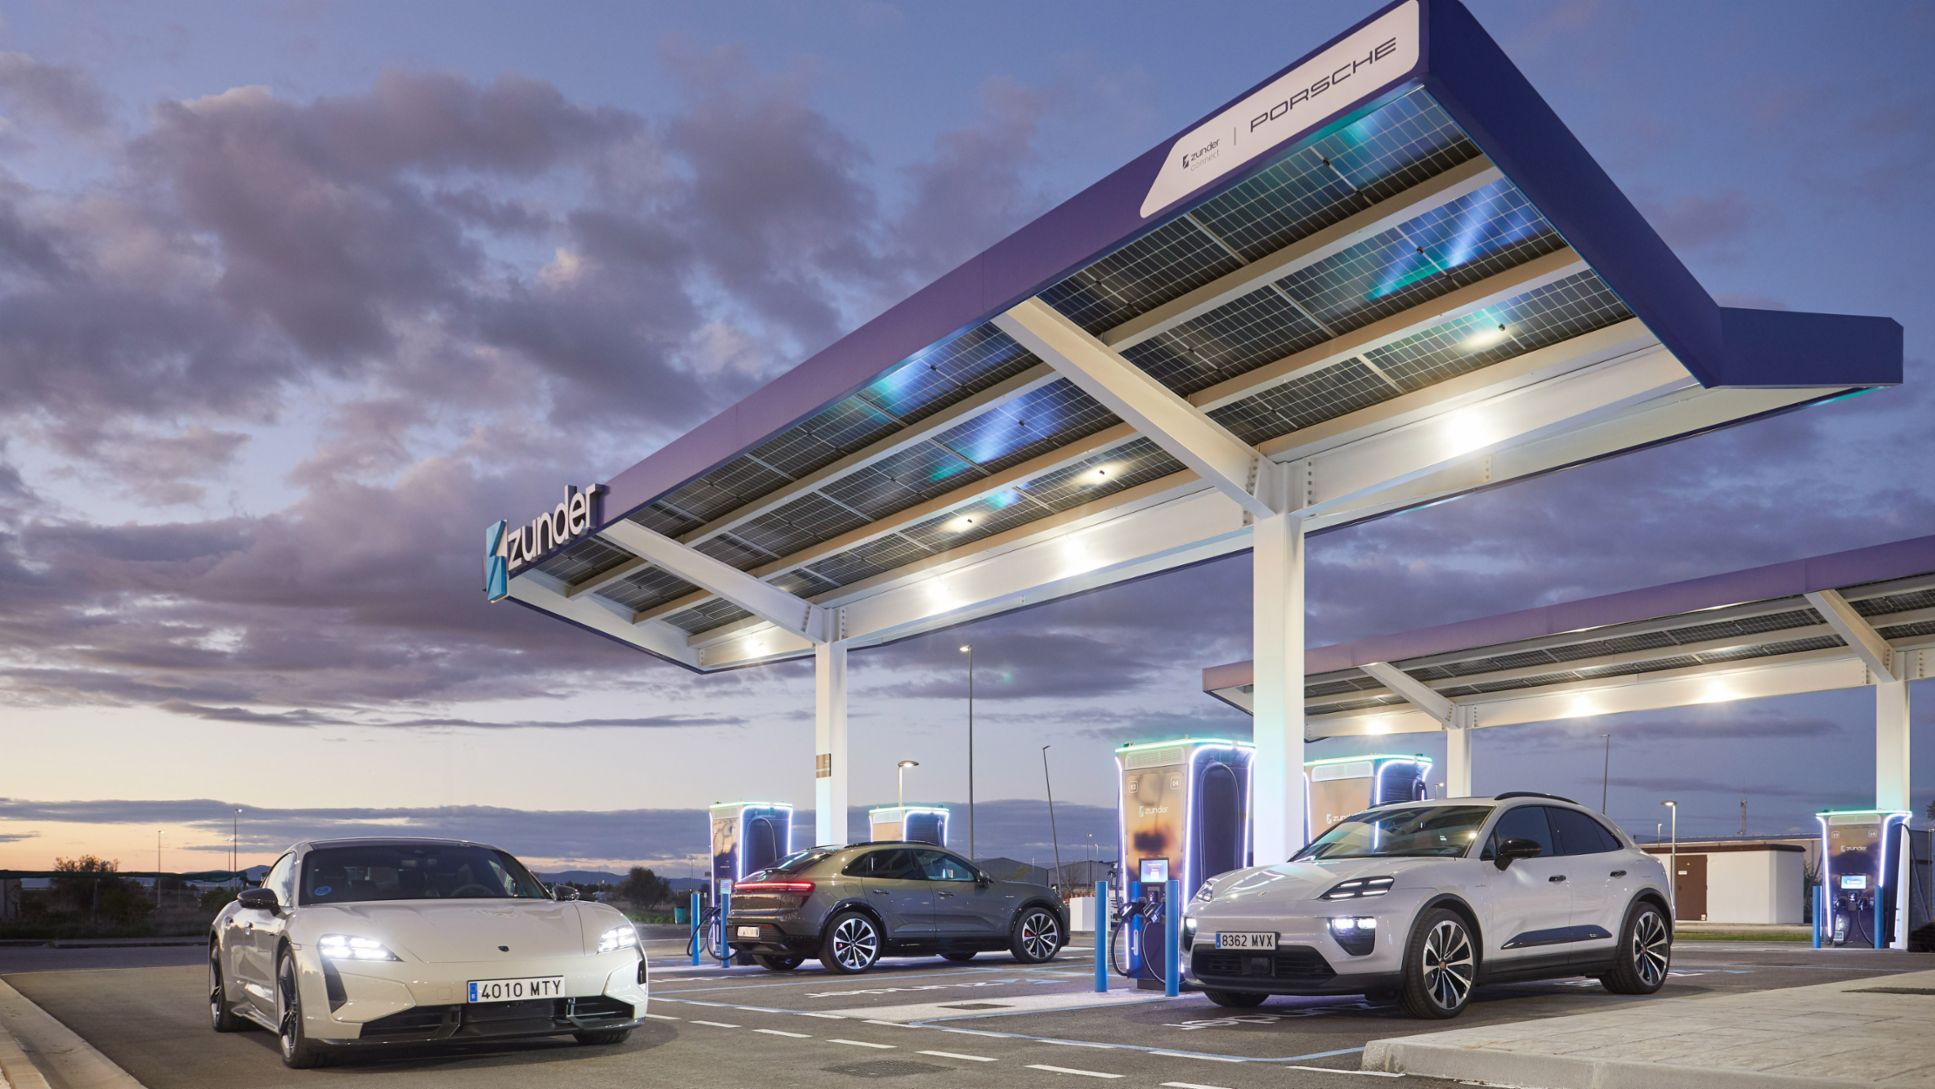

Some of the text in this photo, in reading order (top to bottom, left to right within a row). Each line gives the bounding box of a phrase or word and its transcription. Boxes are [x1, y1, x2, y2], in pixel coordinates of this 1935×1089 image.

[1250, 37, 1397, 133] PORSCHE
[1191, 138, 1220, 161] zunder
[507, 483, 597, 571] zunder
[1222, 934, 1273, 947] 8362 MVX
[481, 980, 561, 999] 4010 MTY
